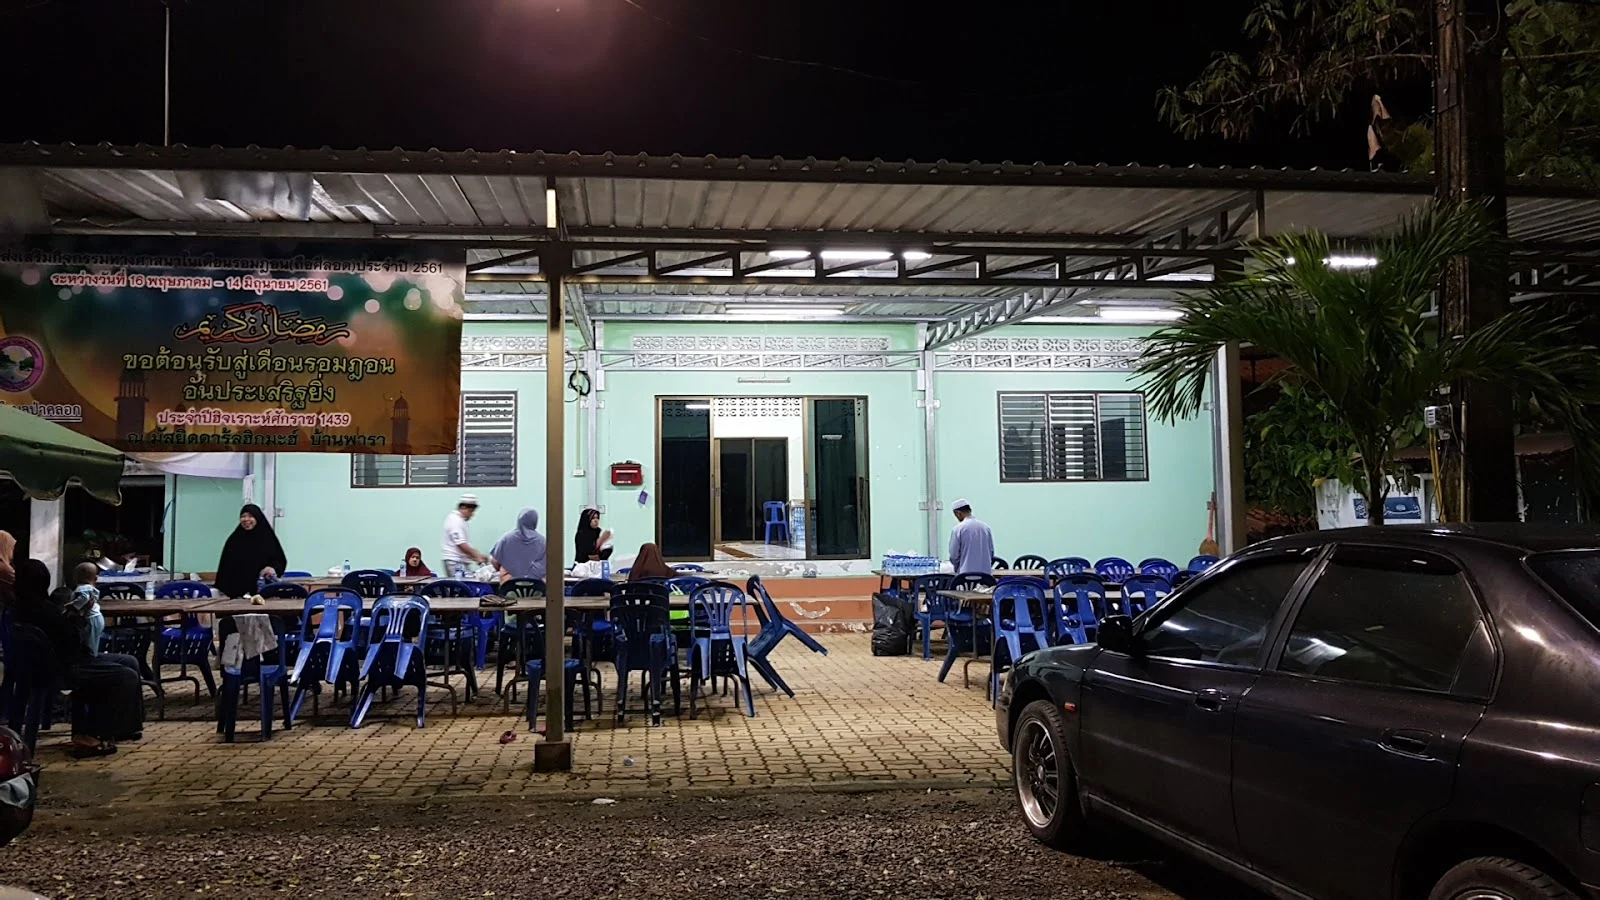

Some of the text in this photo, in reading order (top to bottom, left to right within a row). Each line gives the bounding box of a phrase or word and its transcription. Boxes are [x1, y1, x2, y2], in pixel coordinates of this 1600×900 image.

[412, 261, 443, 274] 2561
[51, 269, 127, 286] ระหว่างวันที่
[130, 274, 145, 287] 16
[146, 276, 212, 291] พฤษภาคม
[226, 276, 241, 290] 14
[243, 276, 296, 294] มิถุนายน
[298, 279, 327, 291] 2561
[122, 345, 396, 381] ขอต้อนรับสู่เดือนรอมฎอน
[158, 408, 350, 426] ประจำปีฮิจเราะห์ศักราช 1439
[309, 428, 387, 446] บ้านพารา
